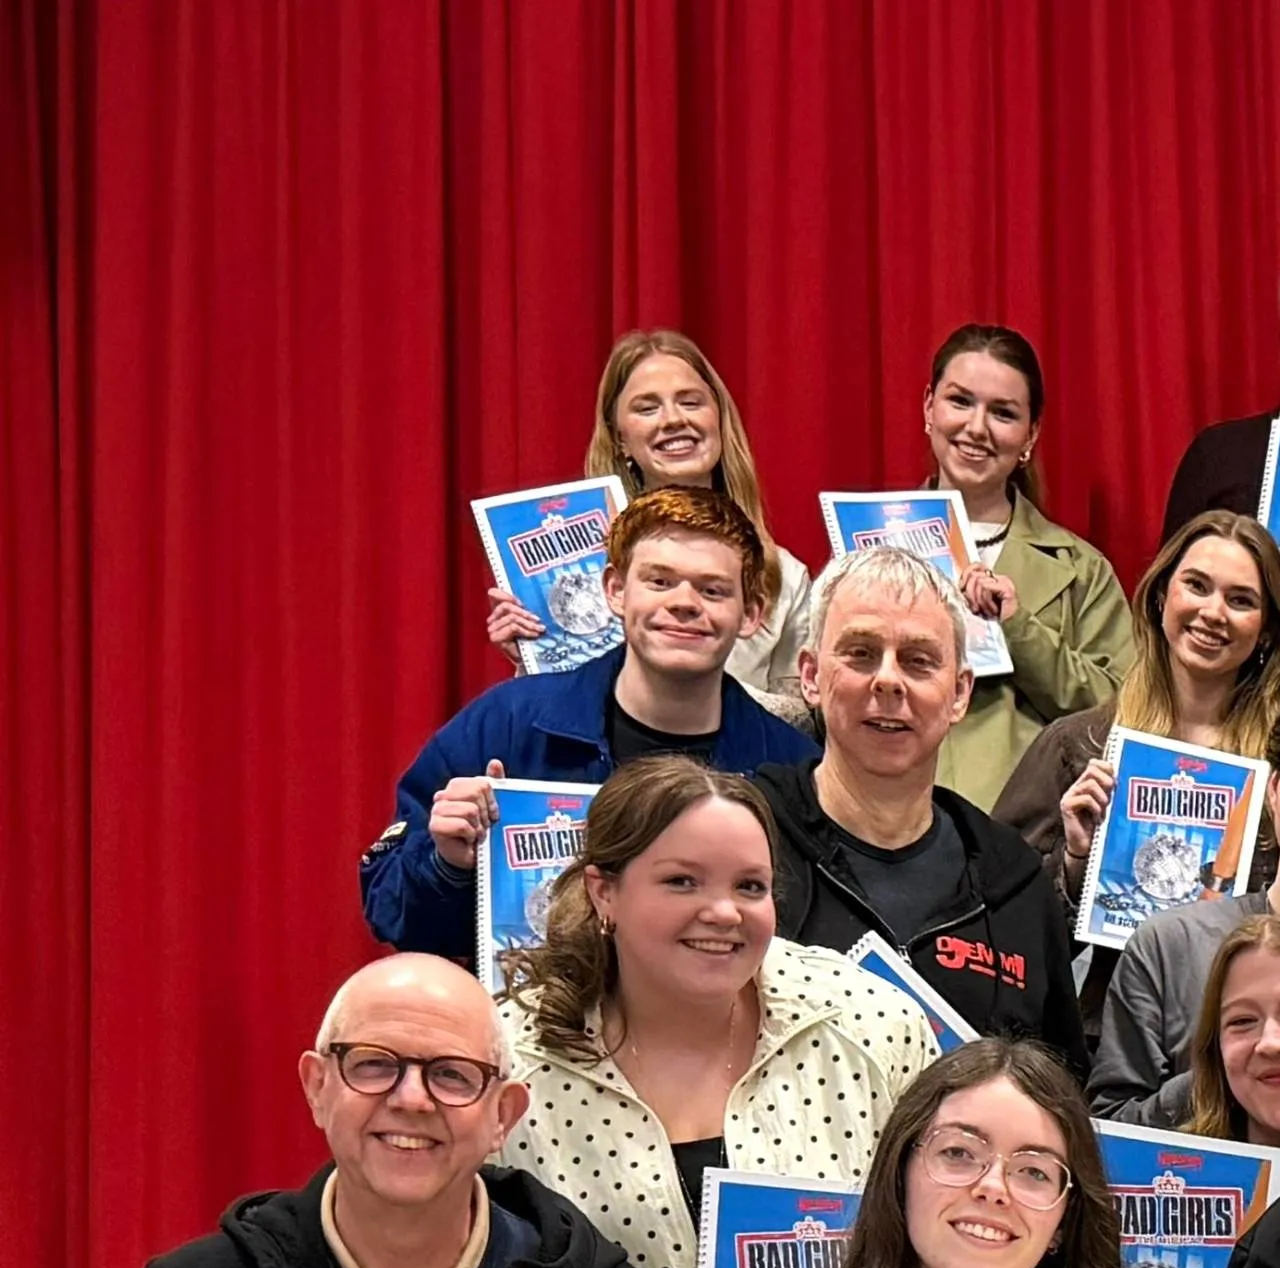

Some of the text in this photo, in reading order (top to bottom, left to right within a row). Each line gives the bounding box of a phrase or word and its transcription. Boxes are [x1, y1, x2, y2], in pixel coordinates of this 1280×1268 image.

[519, 518, 604, 567] BAD GIRLS
[1137, 785, 1226, 820] BAD GIRLS
[513, 831, 554, 861] BAD
[1162, 1197, 1232, 1236] GIRLS
